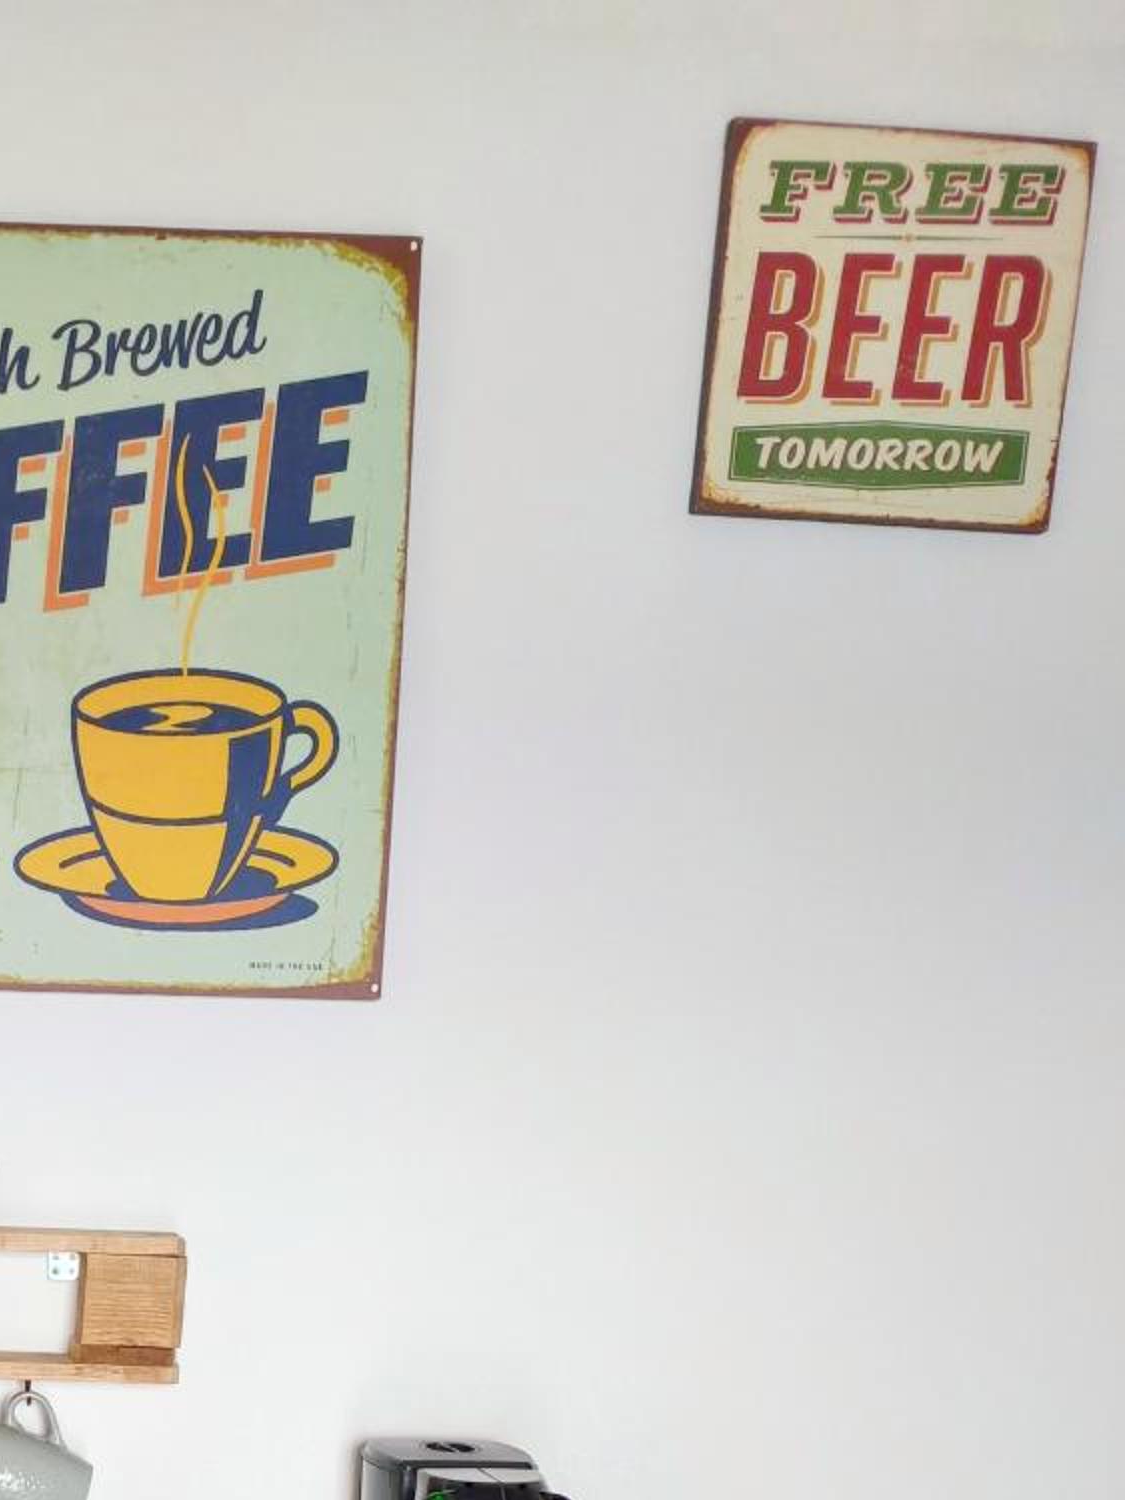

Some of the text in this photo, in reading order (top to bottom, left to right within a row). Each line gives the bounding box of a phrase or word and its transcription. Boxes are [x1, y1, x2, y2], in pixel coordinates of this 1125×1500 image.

[760, 160, 1065, 225] FREE
[52, 289, 267, 392] Brewed
[737, 252, 1052, 408] BEER
[755, 436, 1003, 472] TOMORROW
